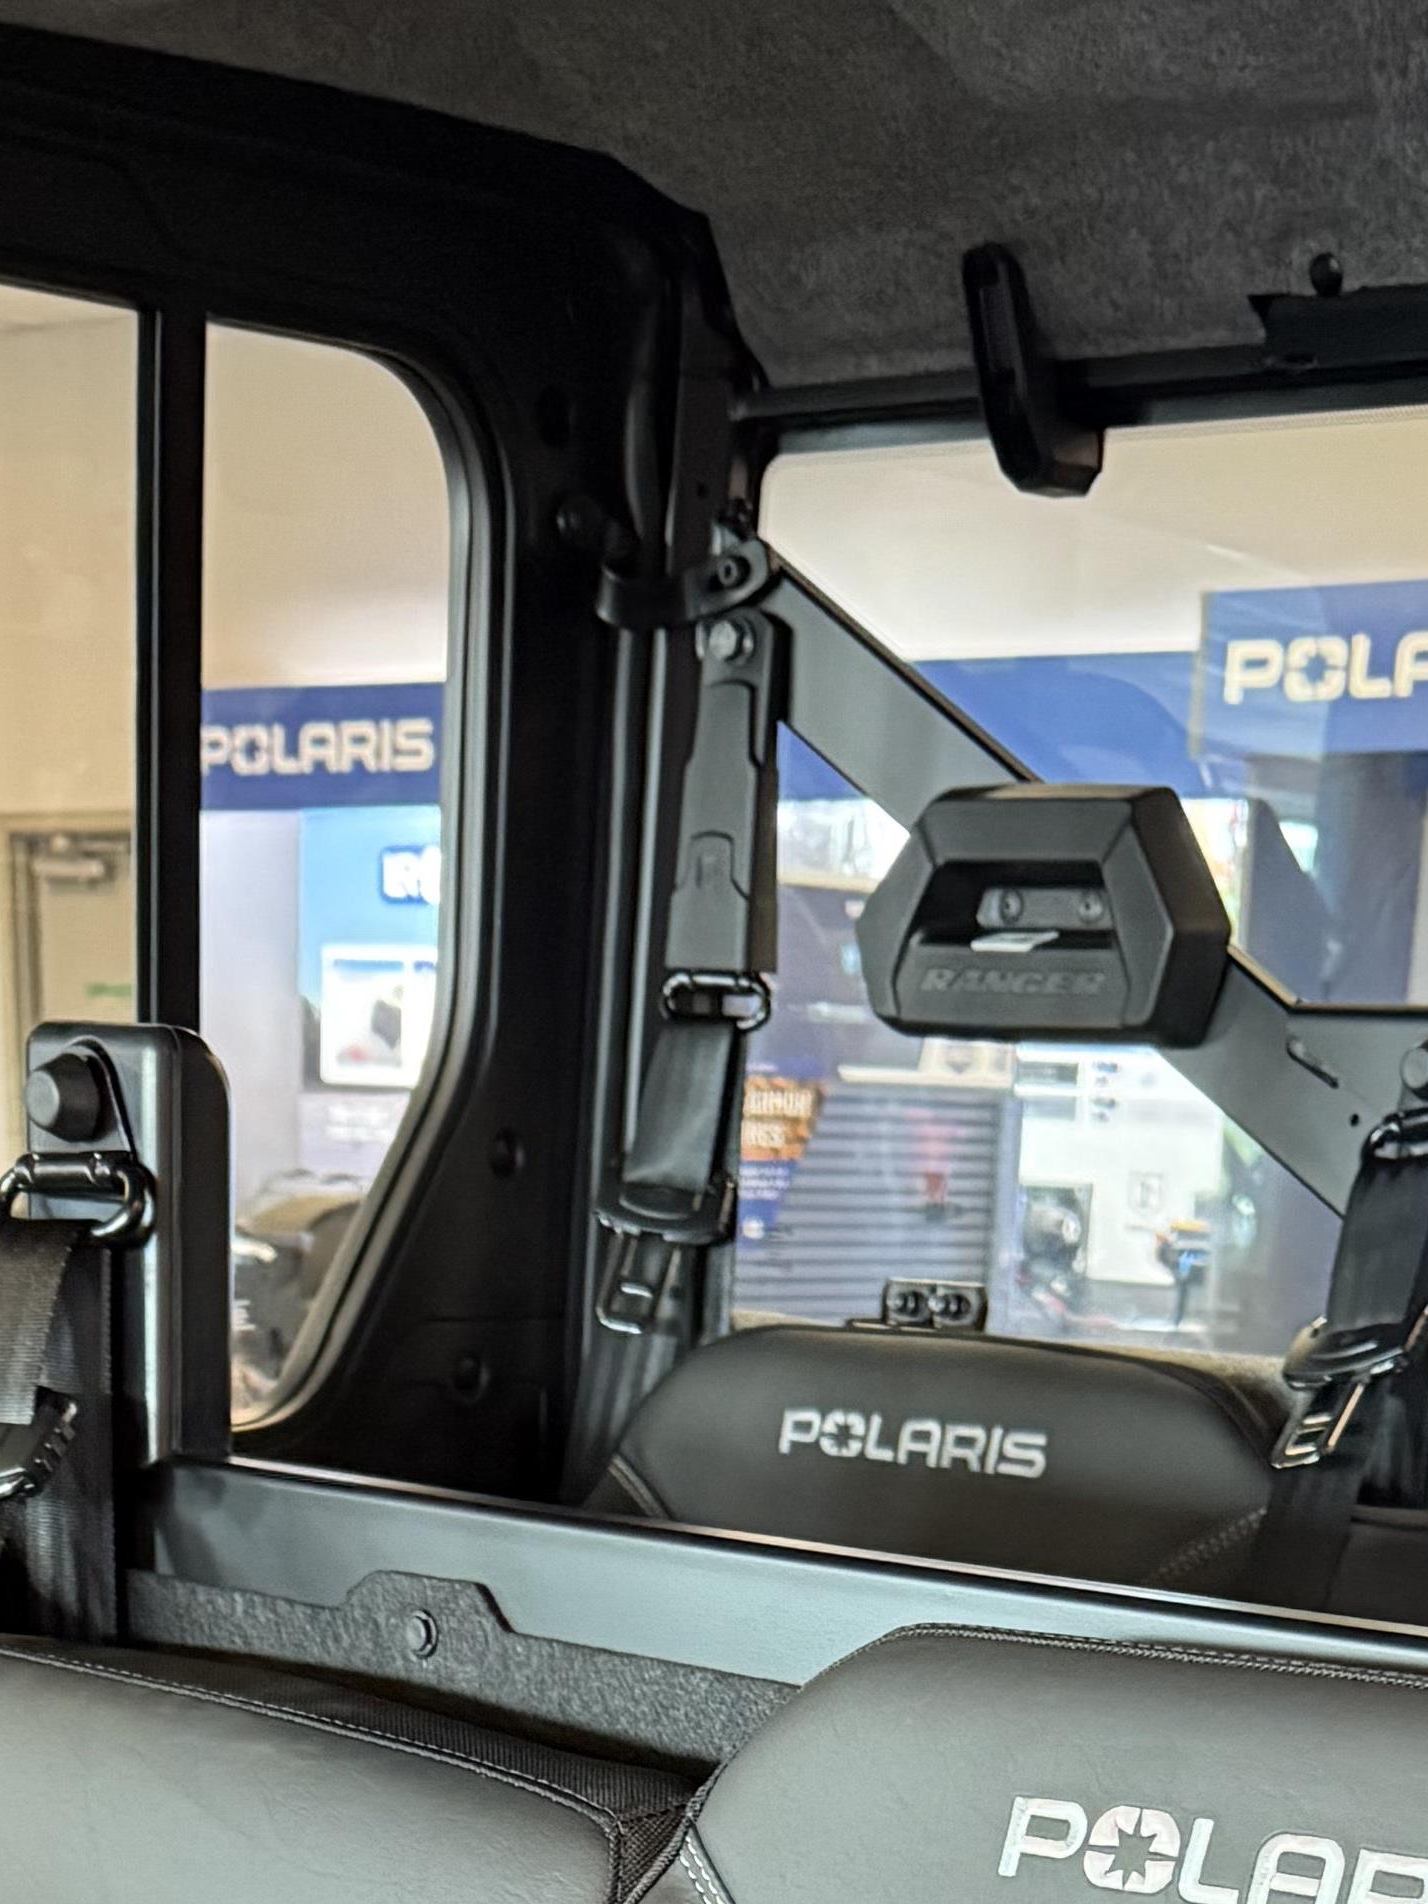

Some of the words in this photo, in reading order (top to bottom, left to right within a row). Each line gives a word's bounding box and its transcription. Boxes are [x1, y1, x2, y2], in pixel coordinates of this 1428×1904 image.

[201, 717, 435, 776] POLARIS
[919, 967, 1105, 995] RANGER
[778, 1408, 1047, 1478] POLARIS
